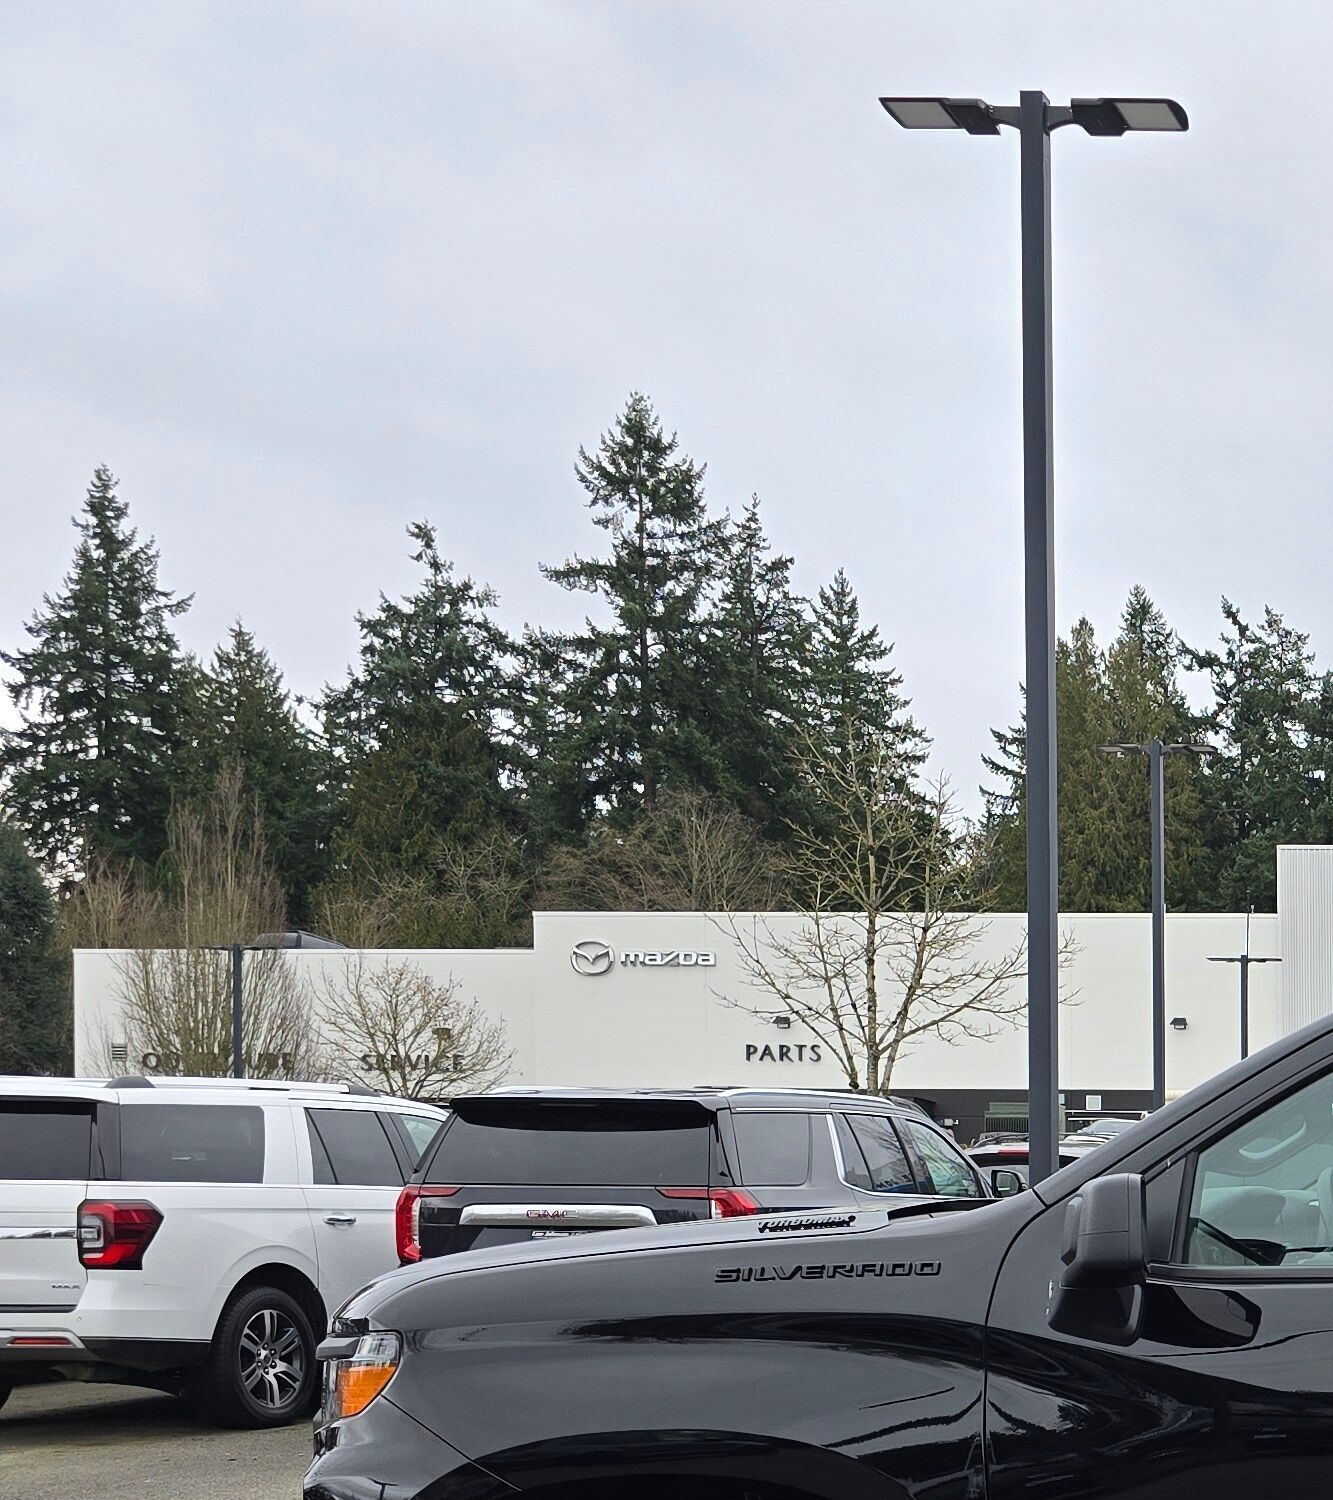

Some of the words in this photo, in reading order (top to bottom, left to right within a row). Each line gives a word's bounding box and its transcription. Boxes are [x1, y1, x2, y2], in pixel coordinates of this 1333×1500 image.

[620, 950, 717, 967] mazda
[745, 1043, 822, 1062] PARTS
[360, 1053, 465, 1072] SERVIE
[526, 1209, 579, 1219] GMC
[714, 1260, 942, 1284] SILVERADO
